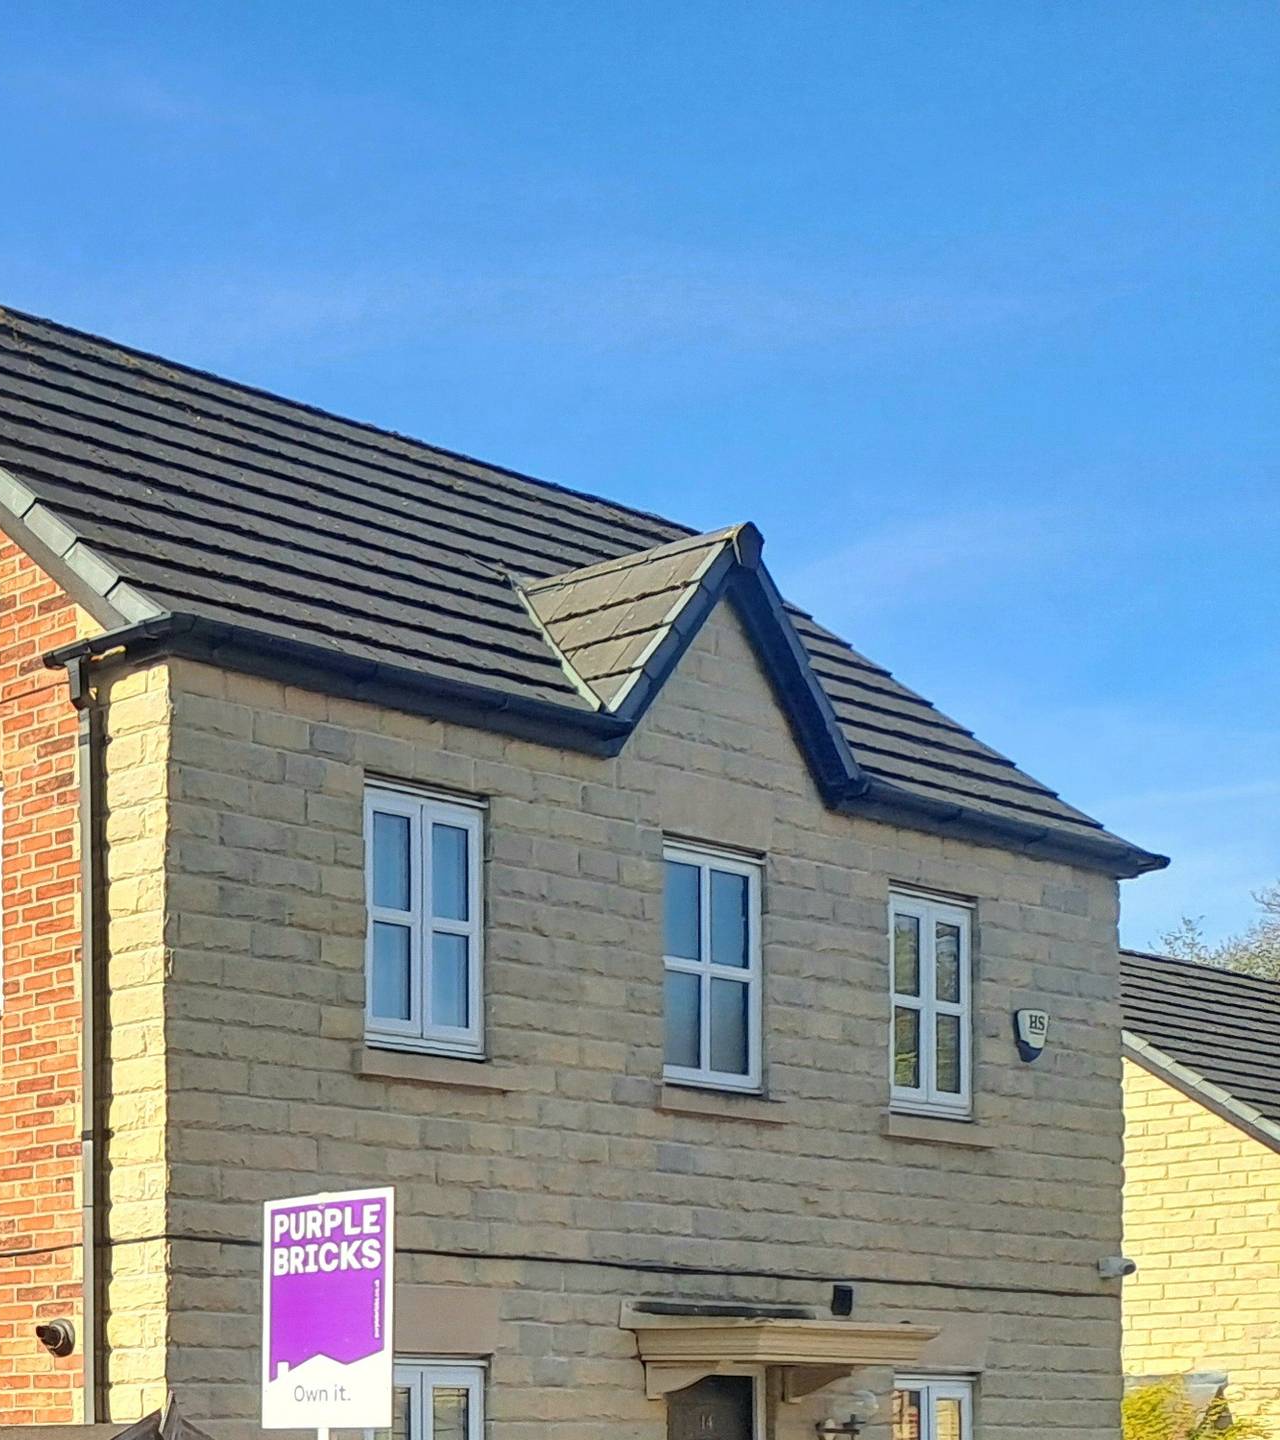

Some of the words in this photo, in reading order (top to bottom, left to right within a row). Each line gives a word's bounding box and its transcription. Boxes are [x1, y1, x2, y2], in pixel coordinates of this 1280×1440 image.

[1029, 1014, 1045, 1031] HS
[274, 1204, 381, 1243] PURPLE
[273, 1239, 382, 1276] BRICKS
[293, 1385, 328, 1402] Own
[334, 1383, 352, 1401] it.
